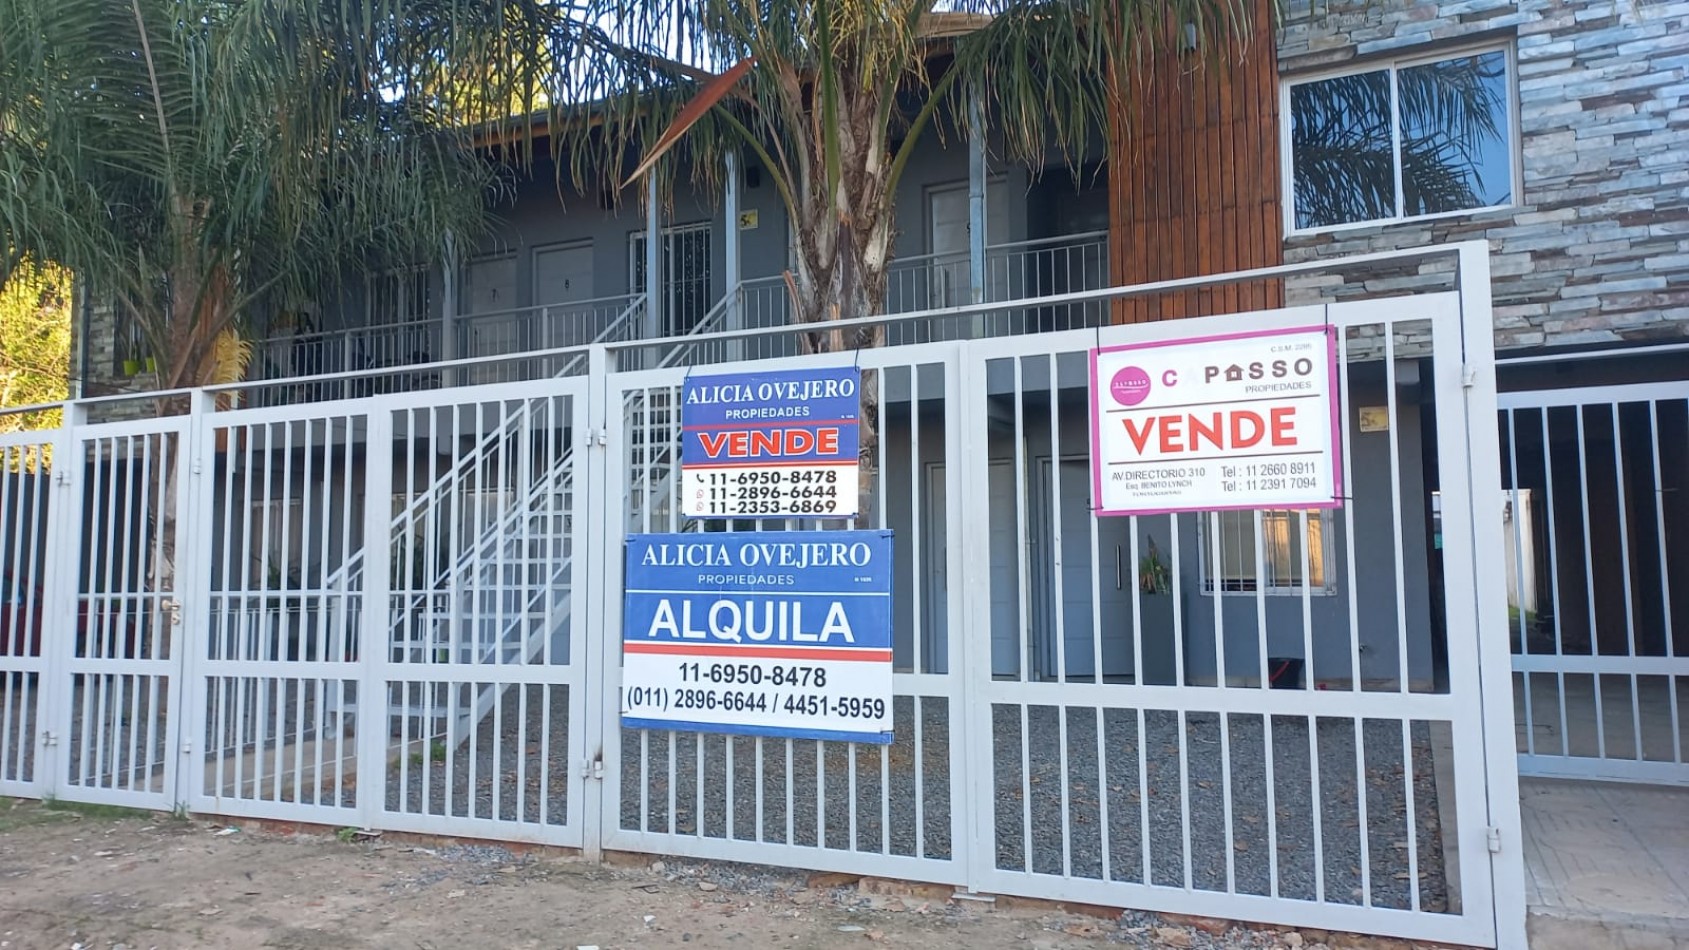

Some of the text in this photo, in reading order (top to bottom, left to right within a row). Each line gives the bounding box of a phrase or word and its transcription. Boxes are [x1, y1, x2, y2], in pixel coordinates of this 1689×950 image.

[686, 378, 855, 405] ALICIA OVEJERO
[1245, 381, 1312, 393] PROPIEDADES
[725, 406, 810, 419] PROPIEDADES
[1121, 407, 1298, 456] VENDE
[697, 427, 839, 458] VENDE
[1188, 467, 1206, 477] 310
[1246, 464, 1256, 476] 11
[1260, 462, 1287, 476] 2660
[1290, 461, 1315, 475] 8911
[710, 470, 837, 485] 11-6950-8478
[1168, 480, 1192, 488] LYNCH
[1246, 479, 1256, 491] 11
[1260, 478, 1286, 490] 2391
[1290, 477, 1316, 489] 7094
[710, 485, 837, 500] 11-2896-6644
[710, 500, 837, 514] 11-2353-6869
[641, 542, 872, 569] ALICIA OVEJERO
[698, 574, 795, 585] PROPIEDADES
[648, 598, 855, 644] ALQUILA
[678, 662, 827, 688] 11-6950-8478
[627, 686, 669, 712] (011)
[674, 688, 767, 713] 2896-6644
[783, 694, 885, 720] 4451-5959
